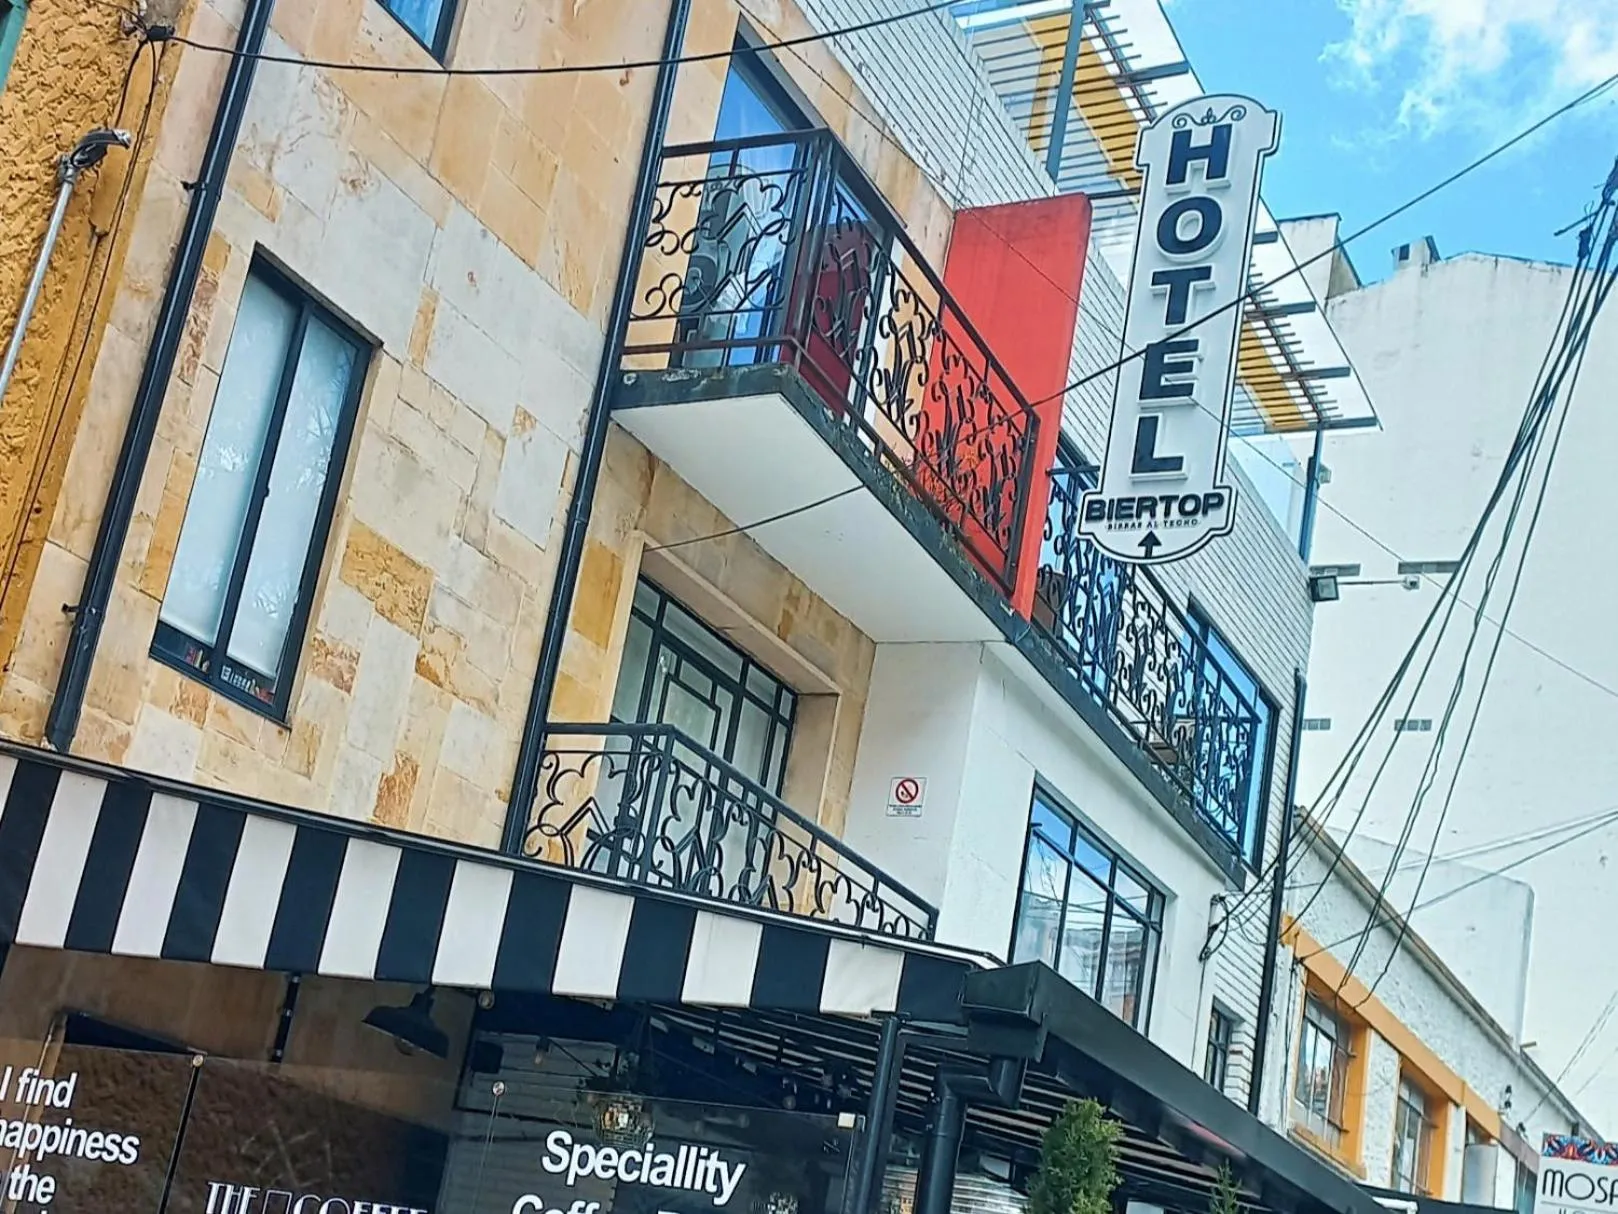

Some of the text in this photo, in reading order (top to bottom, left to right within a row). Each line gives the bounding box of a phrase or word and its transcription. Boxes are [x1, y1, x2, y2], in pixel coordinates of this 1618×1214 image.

[1131, 124, 1233, 474] HOTEL
[1084, 492, 1224, 521] BIERTOP
[15, 1067, 78, 1109] find
[0, 1117, 140, 1165] appiness
[8, 1164, 56, 1204] the
[541, 1130, 747, 1206] Speciallity
